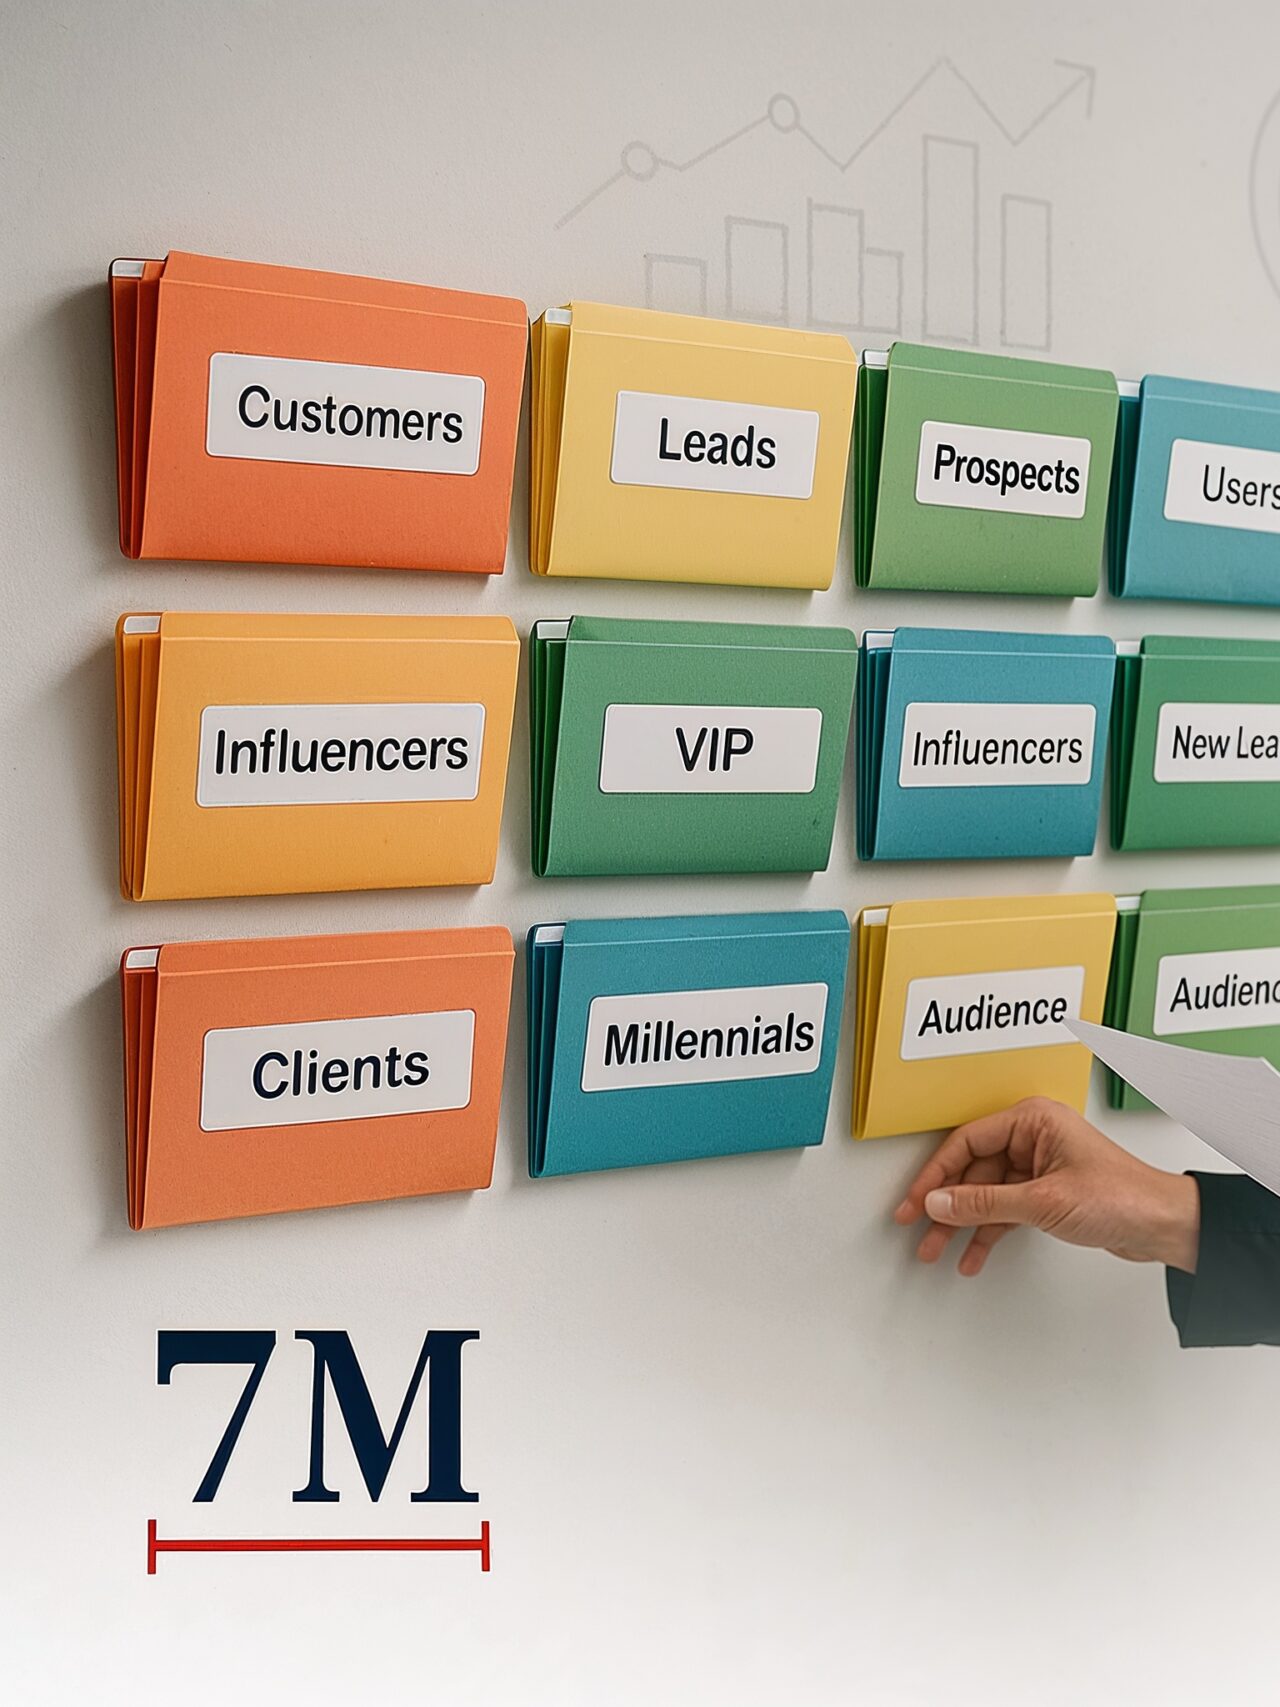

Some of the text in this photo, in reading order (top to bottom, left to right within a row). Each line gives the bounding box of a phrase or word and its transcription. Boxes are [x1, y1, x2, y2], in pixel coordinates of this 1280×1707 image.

[238, 384, 465, 444] Customers
[658, 417, 776, 469] Leads
[934, 442, 1081, 496] Prospects
[215, 727, 470, 776] Influencers
[674, 726, 755, 773] VIP
[912, 728, 1084, 768] Influencers
[1171, 724, 1230, 761] New
[604, 1012, 816, 1066] Millennials
[916, 992, 1069, 1038] Audience
[252, 1046, 430, 1099] Clients
